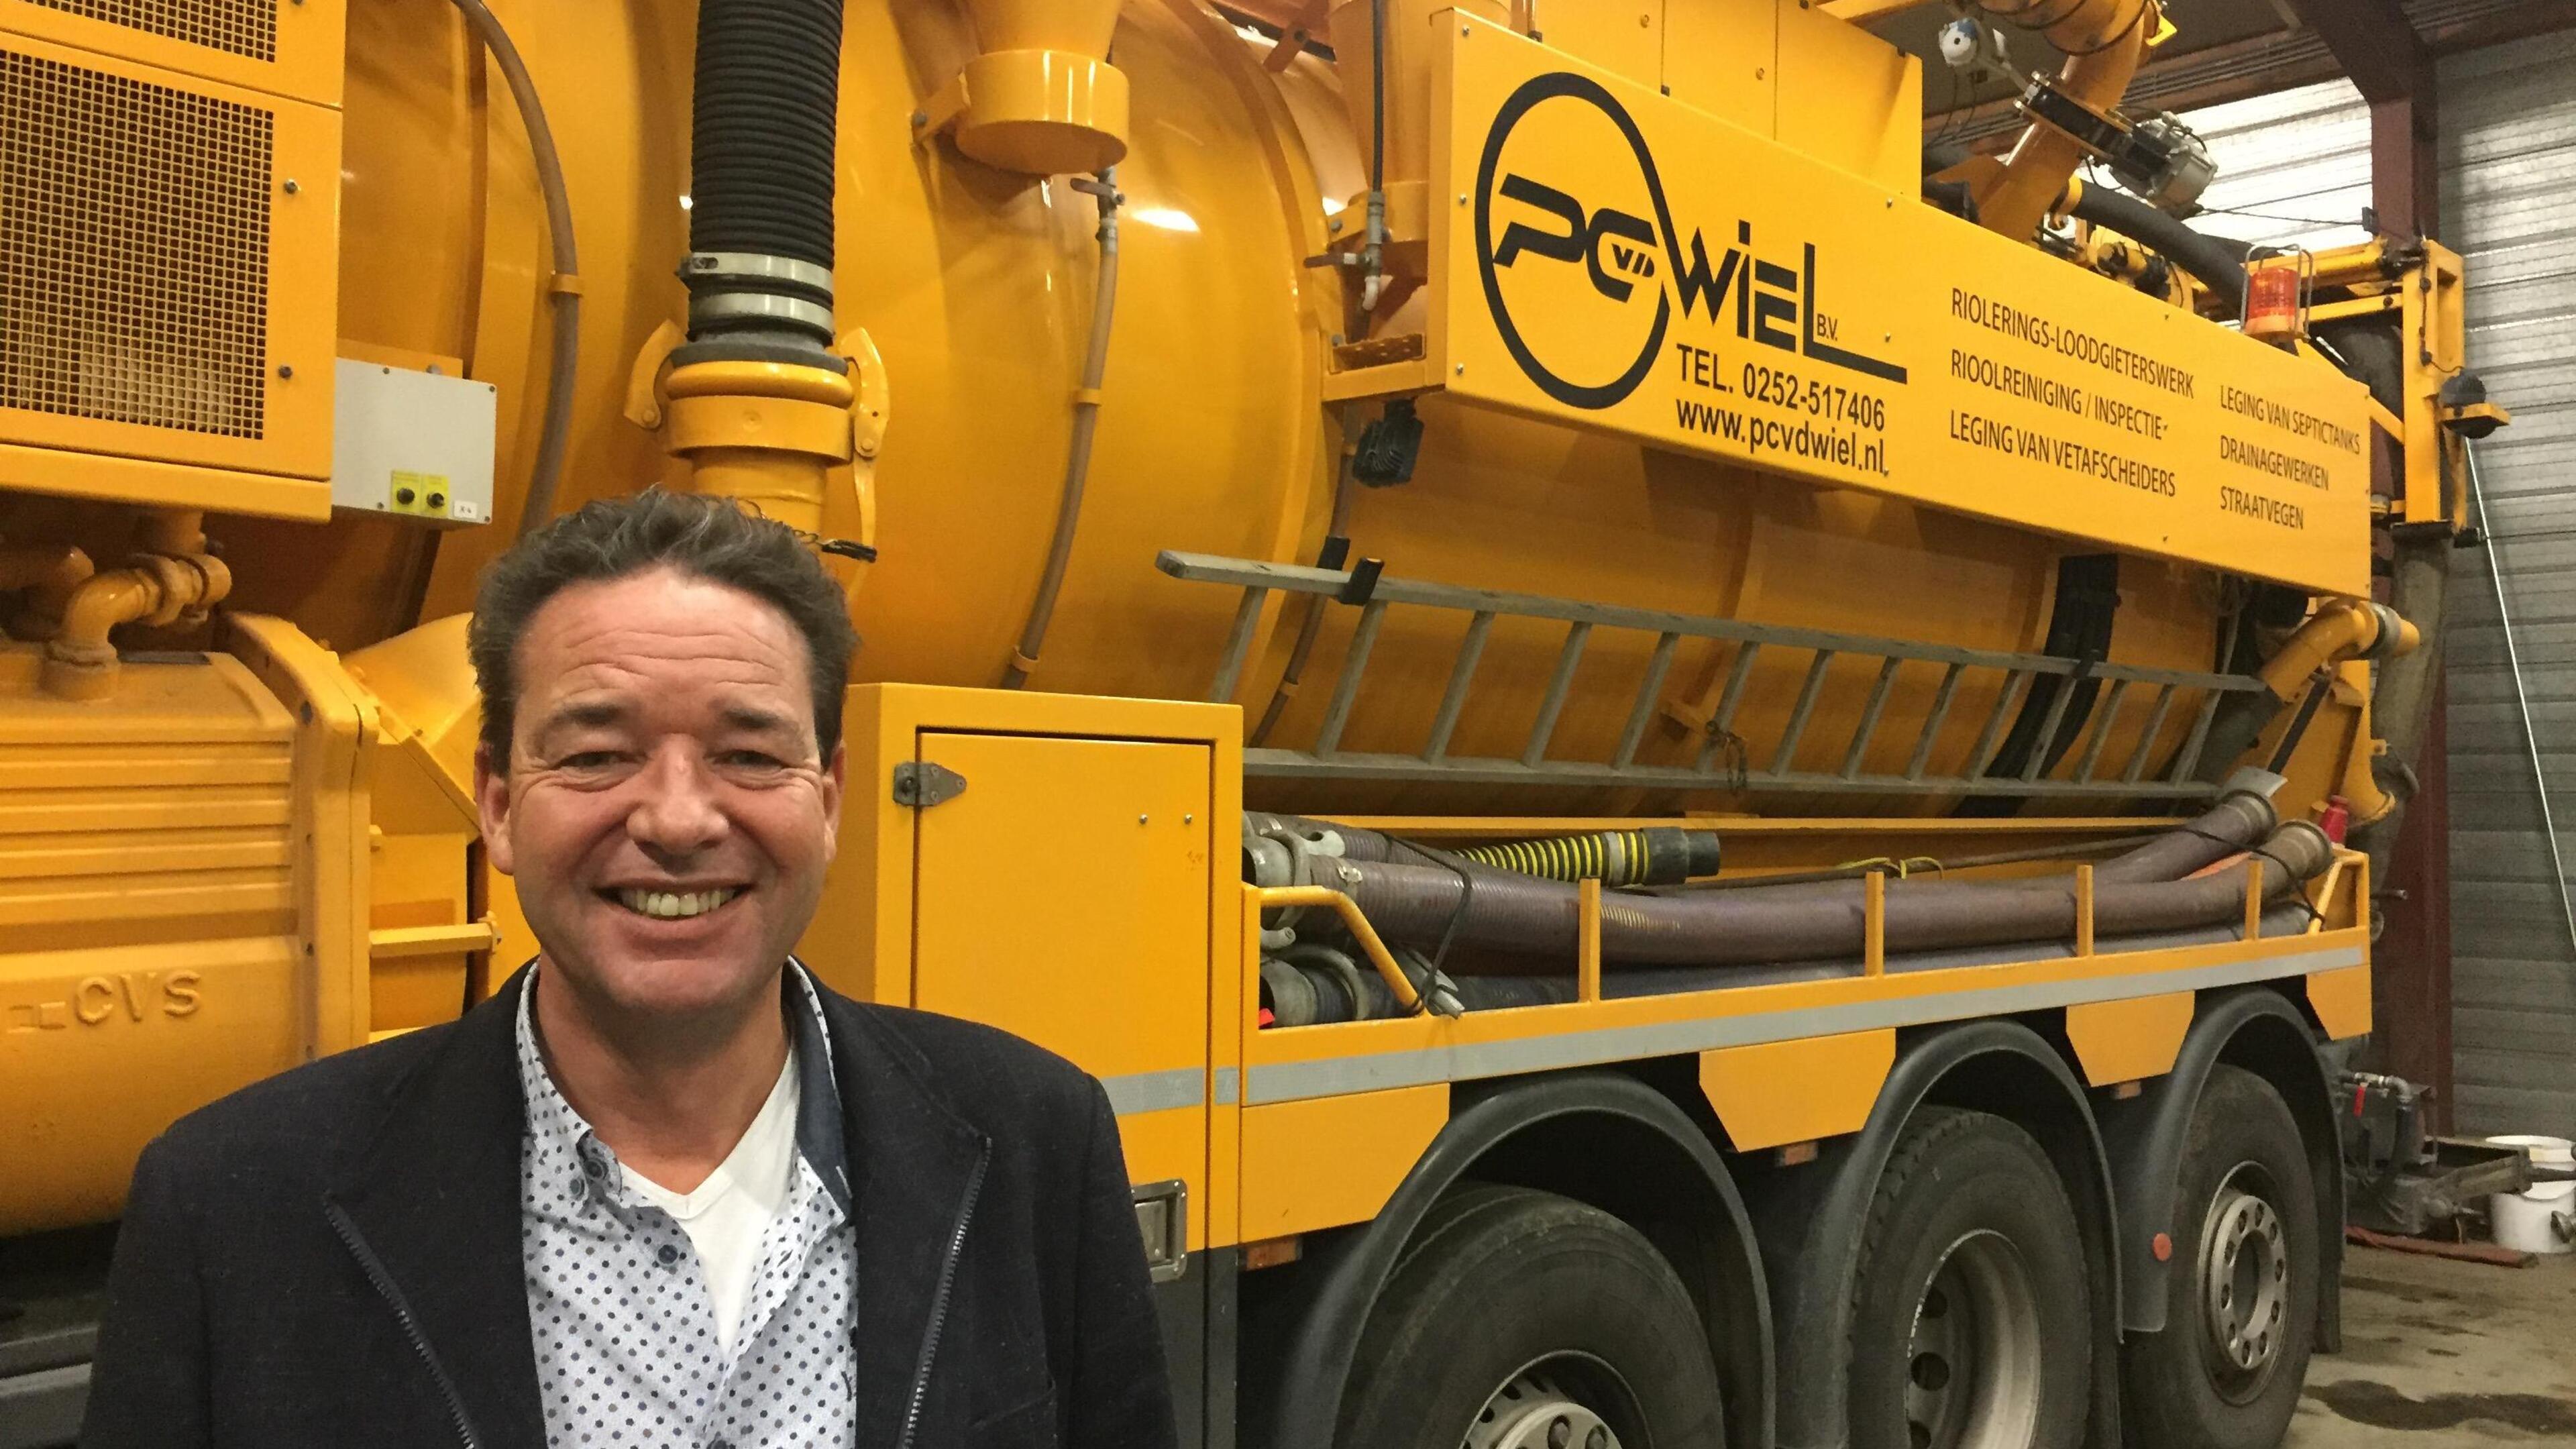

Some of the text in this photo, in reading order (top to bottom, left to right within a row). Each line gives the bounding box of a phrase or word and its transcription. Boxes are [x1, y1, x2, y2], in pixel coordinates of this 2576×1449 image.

[1817, 313, 1838, 341] B.V.
[1951, 287, 2194, 399] RIOLERINGS-LOODGIETERSWERK
[1676, 343, 1885, 431] TEL. 0252-517406
[1951, 348, 2082, 415] RIOOLREINIGING
[2095, 395, 2162, 440] INSPECTIE
[2220, 384, 2360, 455] LEGING VAN SEPTICTANKS
[1676, 398, 1884, 473] www.pcvdwiel.nl
[1950, 409, 2176, 498] LEGING VAN VETAFSCHEIDERS
[2220, 434, 2329, 491] DRAINAGEWERKEN
[2220, 485, 2304, 530] STRAATVEGEN
[74, 969, 201, 1026] CVS
